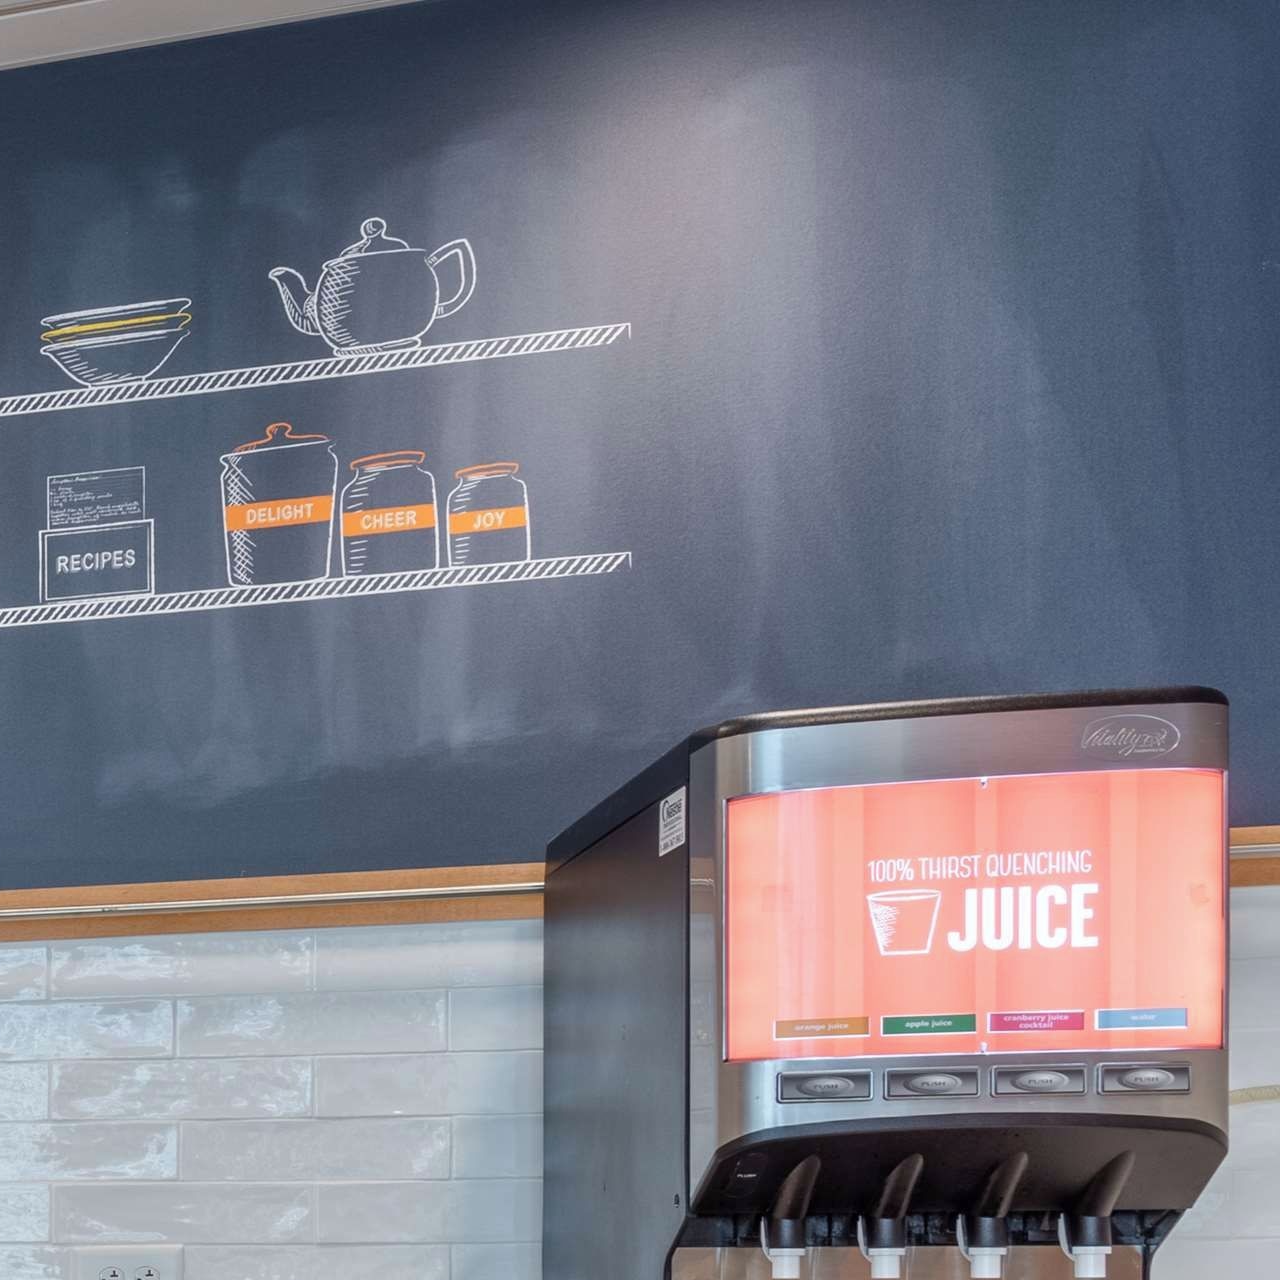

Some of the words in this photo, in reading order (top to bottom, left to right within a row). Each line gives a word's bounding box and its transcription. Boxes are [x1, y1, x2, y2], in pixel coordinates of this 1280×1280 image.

[246, 503, 314, 525] DELIGHT
[360, 510, 417, 530] CHEER
[473, 511, 506, 529] JOY
[56, 548, 136, 575] RECIPES
[867, 858, 915, 883] 100%
[918, 854, 981, 881] THIRST
[985, 849, 1093, 877] QUENCHING
[946, 883, 1100, 952] JUICE
[904, 1019, 930, 1029] apple
[931, 1018, 953, 1028] juice
[1003, 1013, 1045, 1023] cranberry
[1047, 1012, 1069, 1022] juice
[1019, 1021, 1054, 1029] cocktail
[794, 1023, 826, 1033] orange
[827, 1022, 849, 1031] juice
